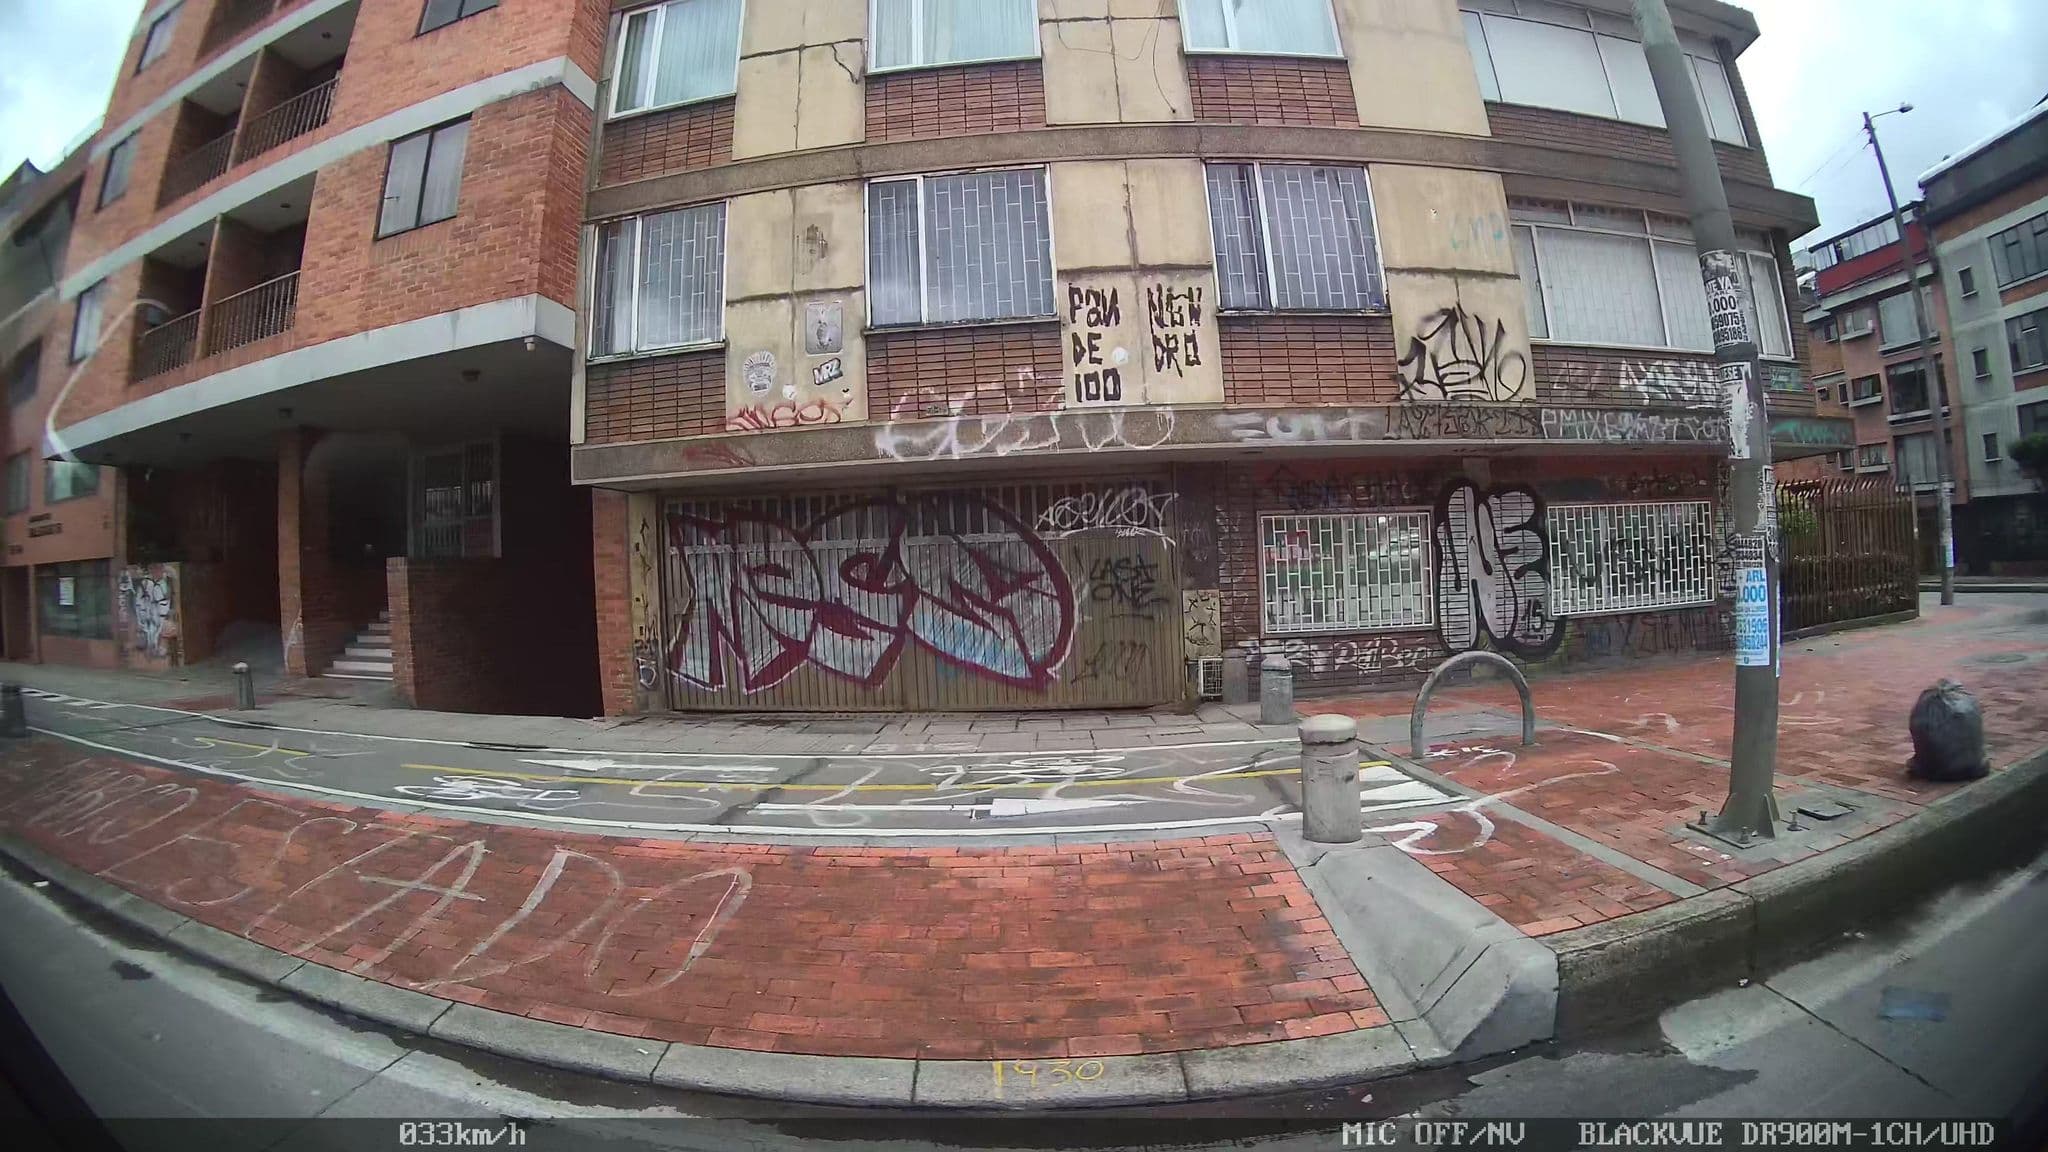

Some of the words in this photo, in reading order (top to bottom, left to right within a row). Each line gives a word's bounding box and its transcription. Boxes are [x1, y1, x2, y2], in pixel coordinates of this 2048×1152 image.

[1718, 275, 1733, 290] YA
[1072, 332, 1103, 368] DE
[1074, 367, 1121, 402] 100
[1746, 570, 1765, 582] ARL
